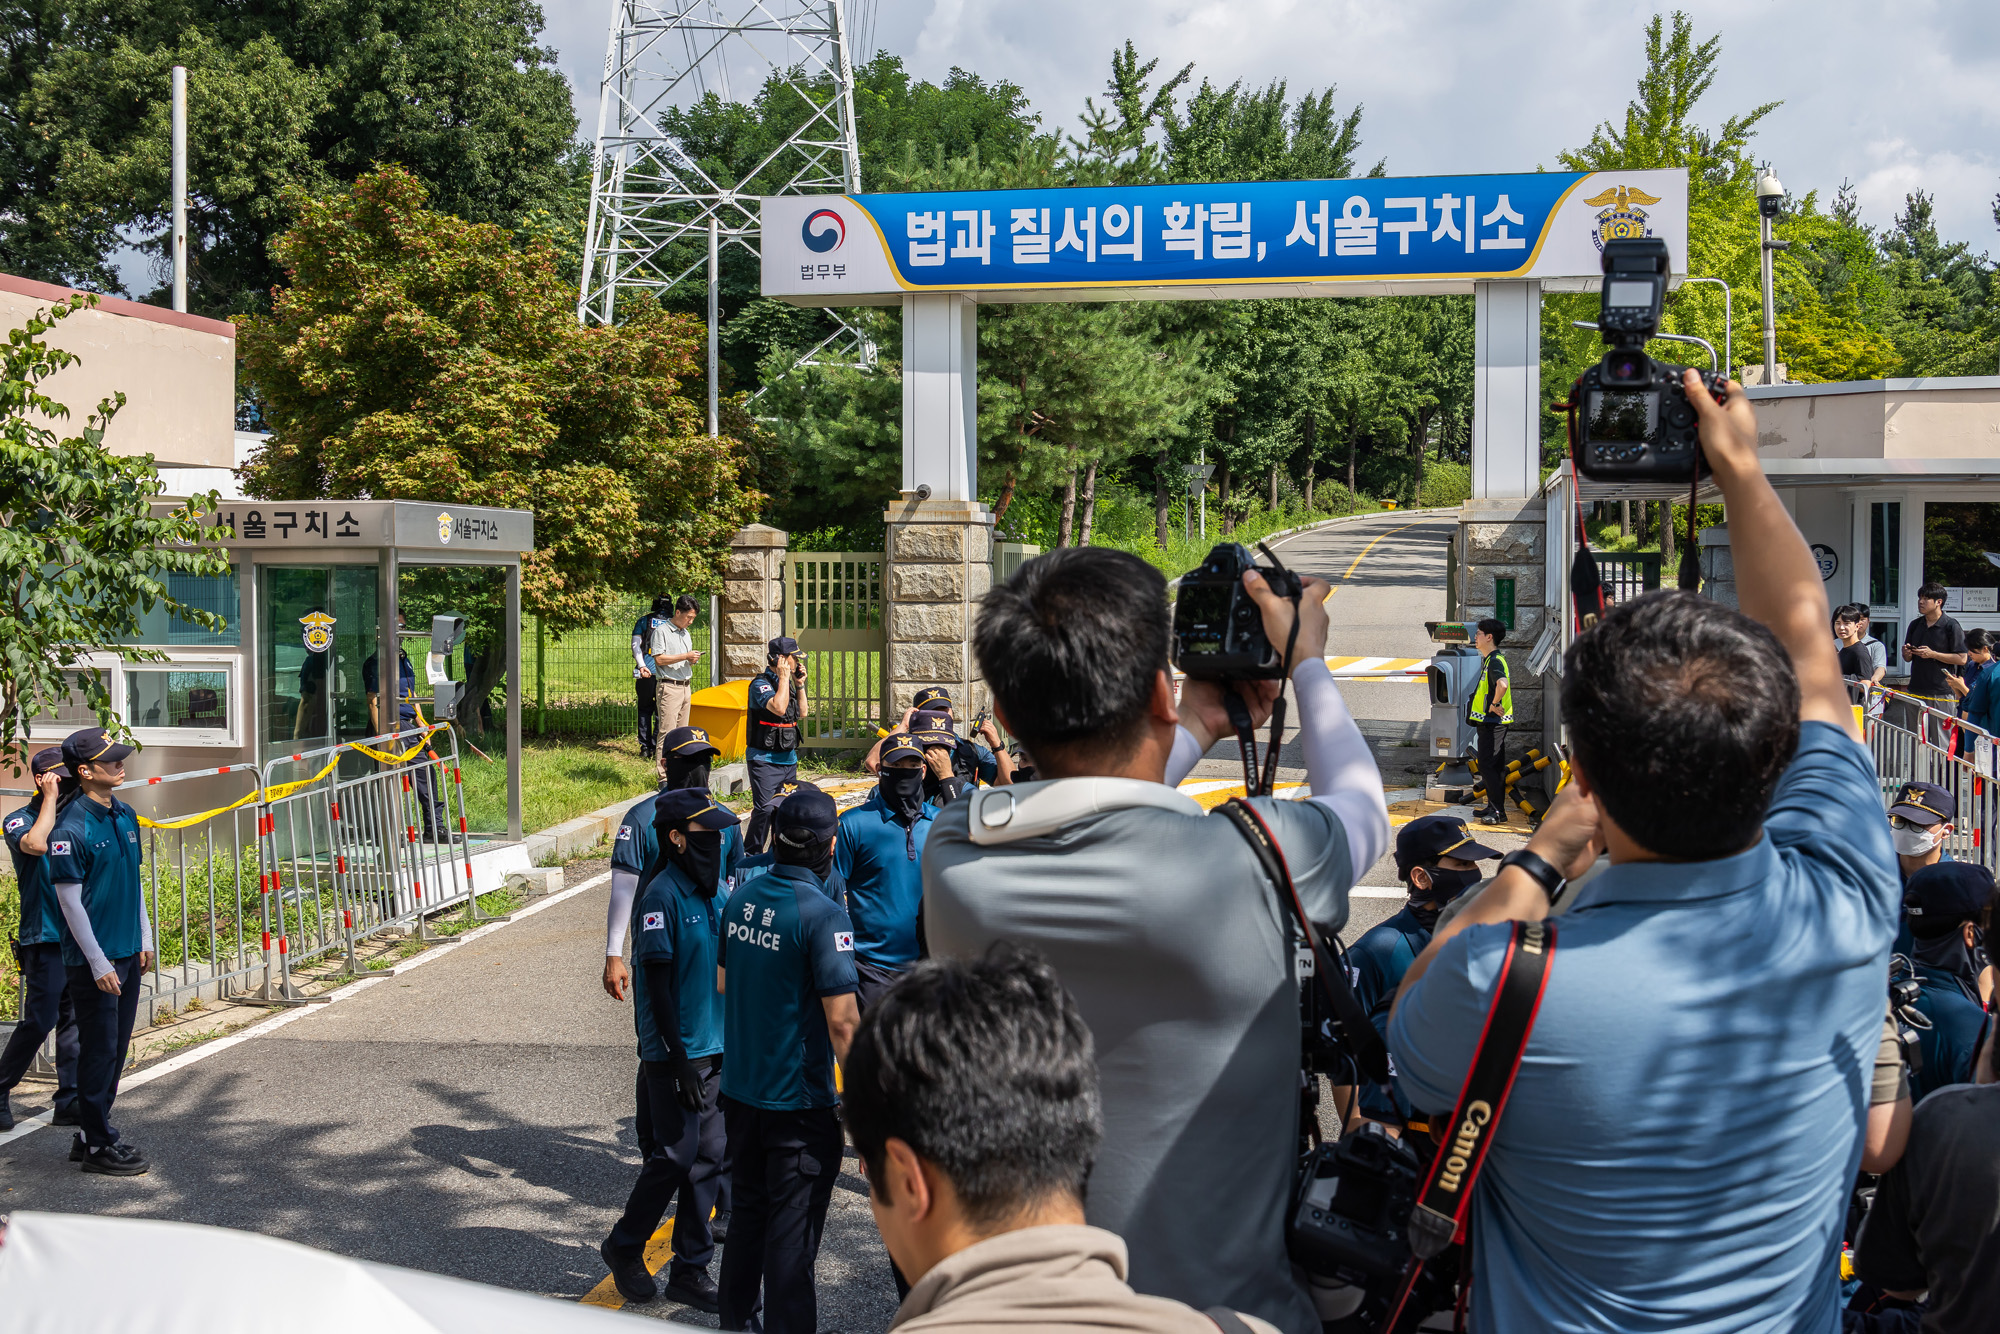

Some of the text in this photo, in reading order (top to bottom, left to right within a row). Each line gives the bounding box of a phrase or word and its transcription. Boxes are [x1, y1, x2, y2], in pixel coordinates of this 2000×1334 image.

[906, 193, 1527, 267] 법과 질서의 확립, 서울구치소
[800, 263, 847, 281] 법무부
[215, 510, 361, 539] 서울구치소
[454, 517, 499, 541] 서울구치소
[1244, 741, 1257, 791] Canon
[727, 921, 781, 952] POLICE
[1438, 1100, 1491, 1193] Canon
